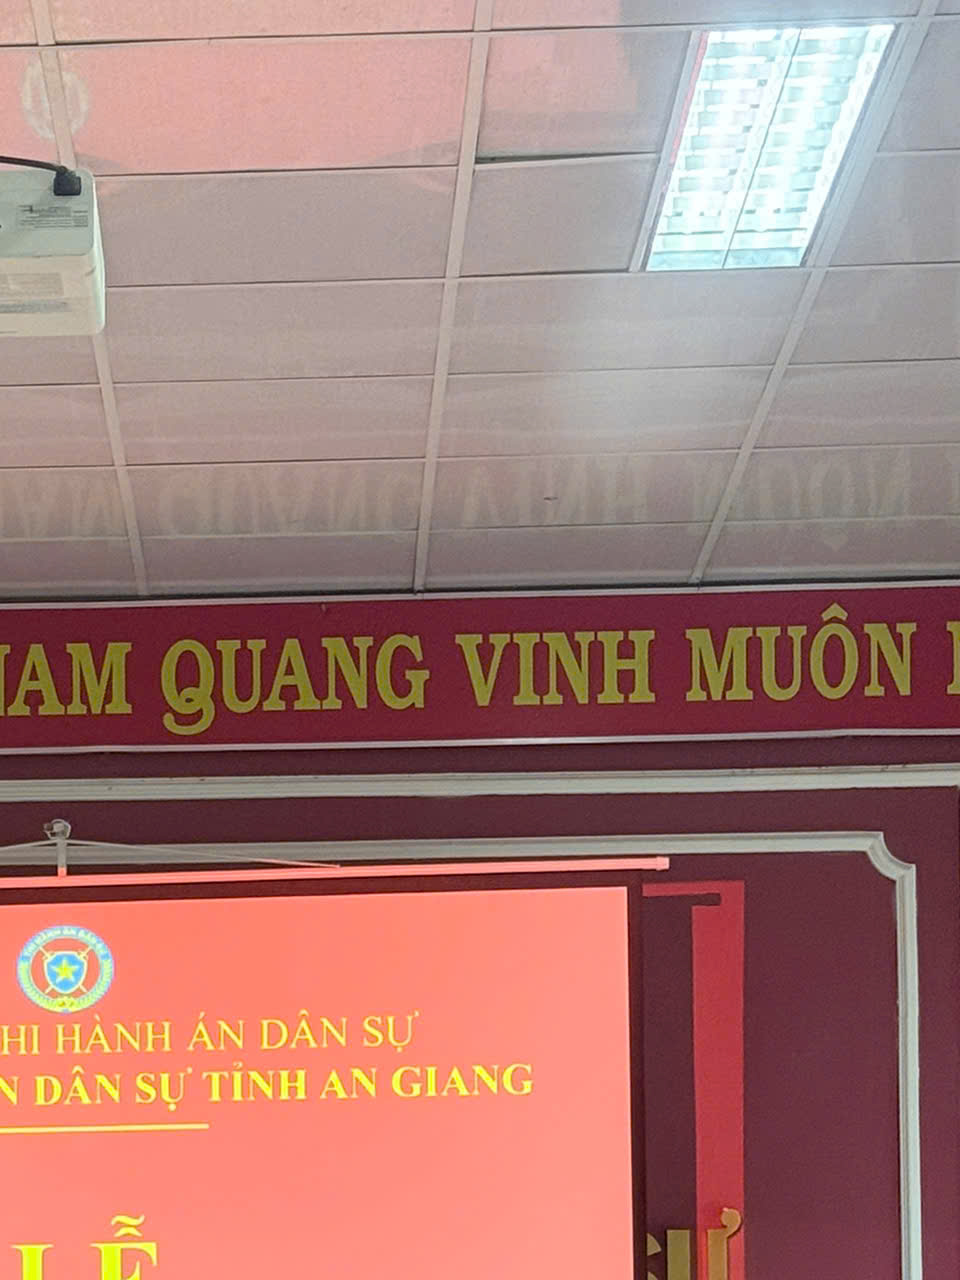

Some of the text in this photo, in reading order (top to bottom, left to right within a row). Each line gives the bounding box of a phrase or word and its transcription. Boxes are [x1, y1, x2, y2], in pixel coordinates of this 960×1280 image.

[160, 634, 430, 736] QUANG
[455, 630, 656, 706] VINH
[685, 602, 917, 702] MUÔN
[55, 1013, 173, 1055] HÀNH
[186, 1010, 246, 1053] ÁN
[259, 1008, 349, 1052] DÂN
[361, 1010, 420, 1053] SỰ
[33, 1064, 122, 1107] DÂN
[134, 1067, 193, 1112] SỰ
[202, 1060, 308, 1102] TỈNH
[319, 1066, 378, 1101] AN
[390, 1063, 534, 1099] GIANG
